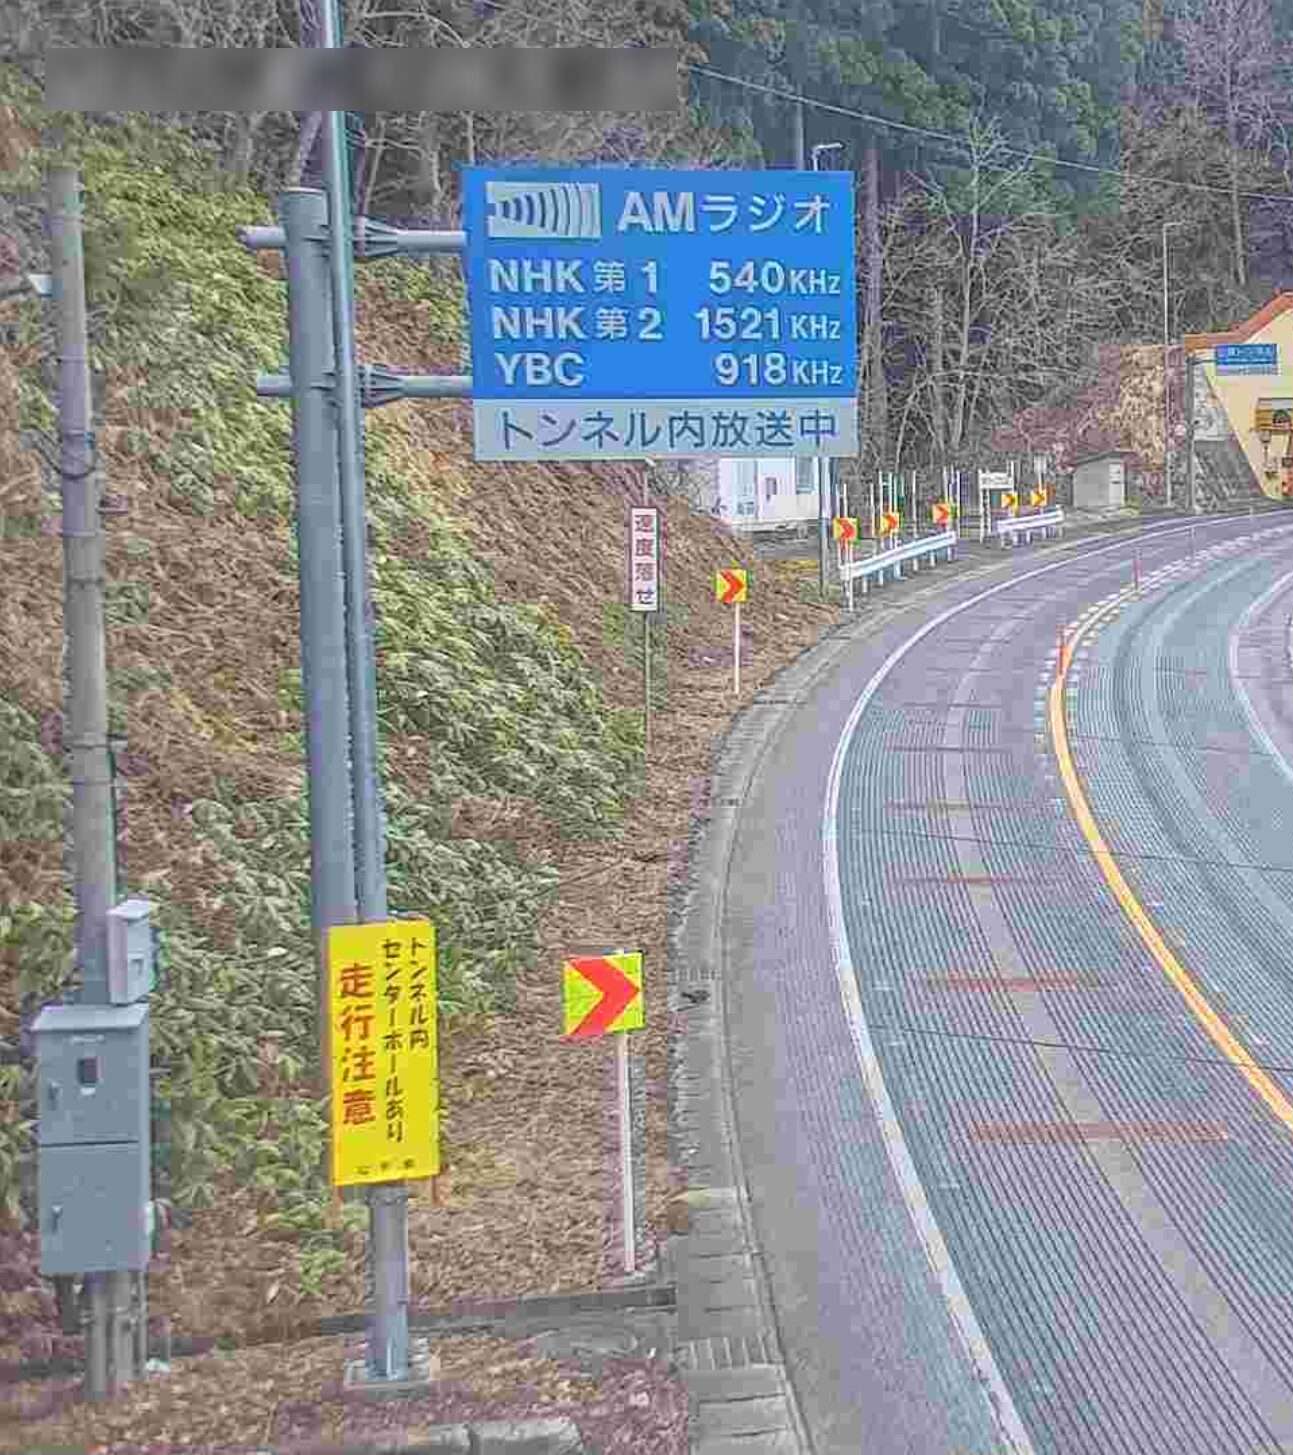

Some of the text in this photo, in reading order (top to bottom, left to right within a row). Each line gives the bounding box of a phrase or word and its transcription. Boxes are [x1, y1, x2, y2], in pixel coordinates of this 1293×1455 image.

[494, 353, 586, 387] YBC
[501, 411, 837, 450] トンネル内放送中
[339, 962, 376, 1126] 走行注意
